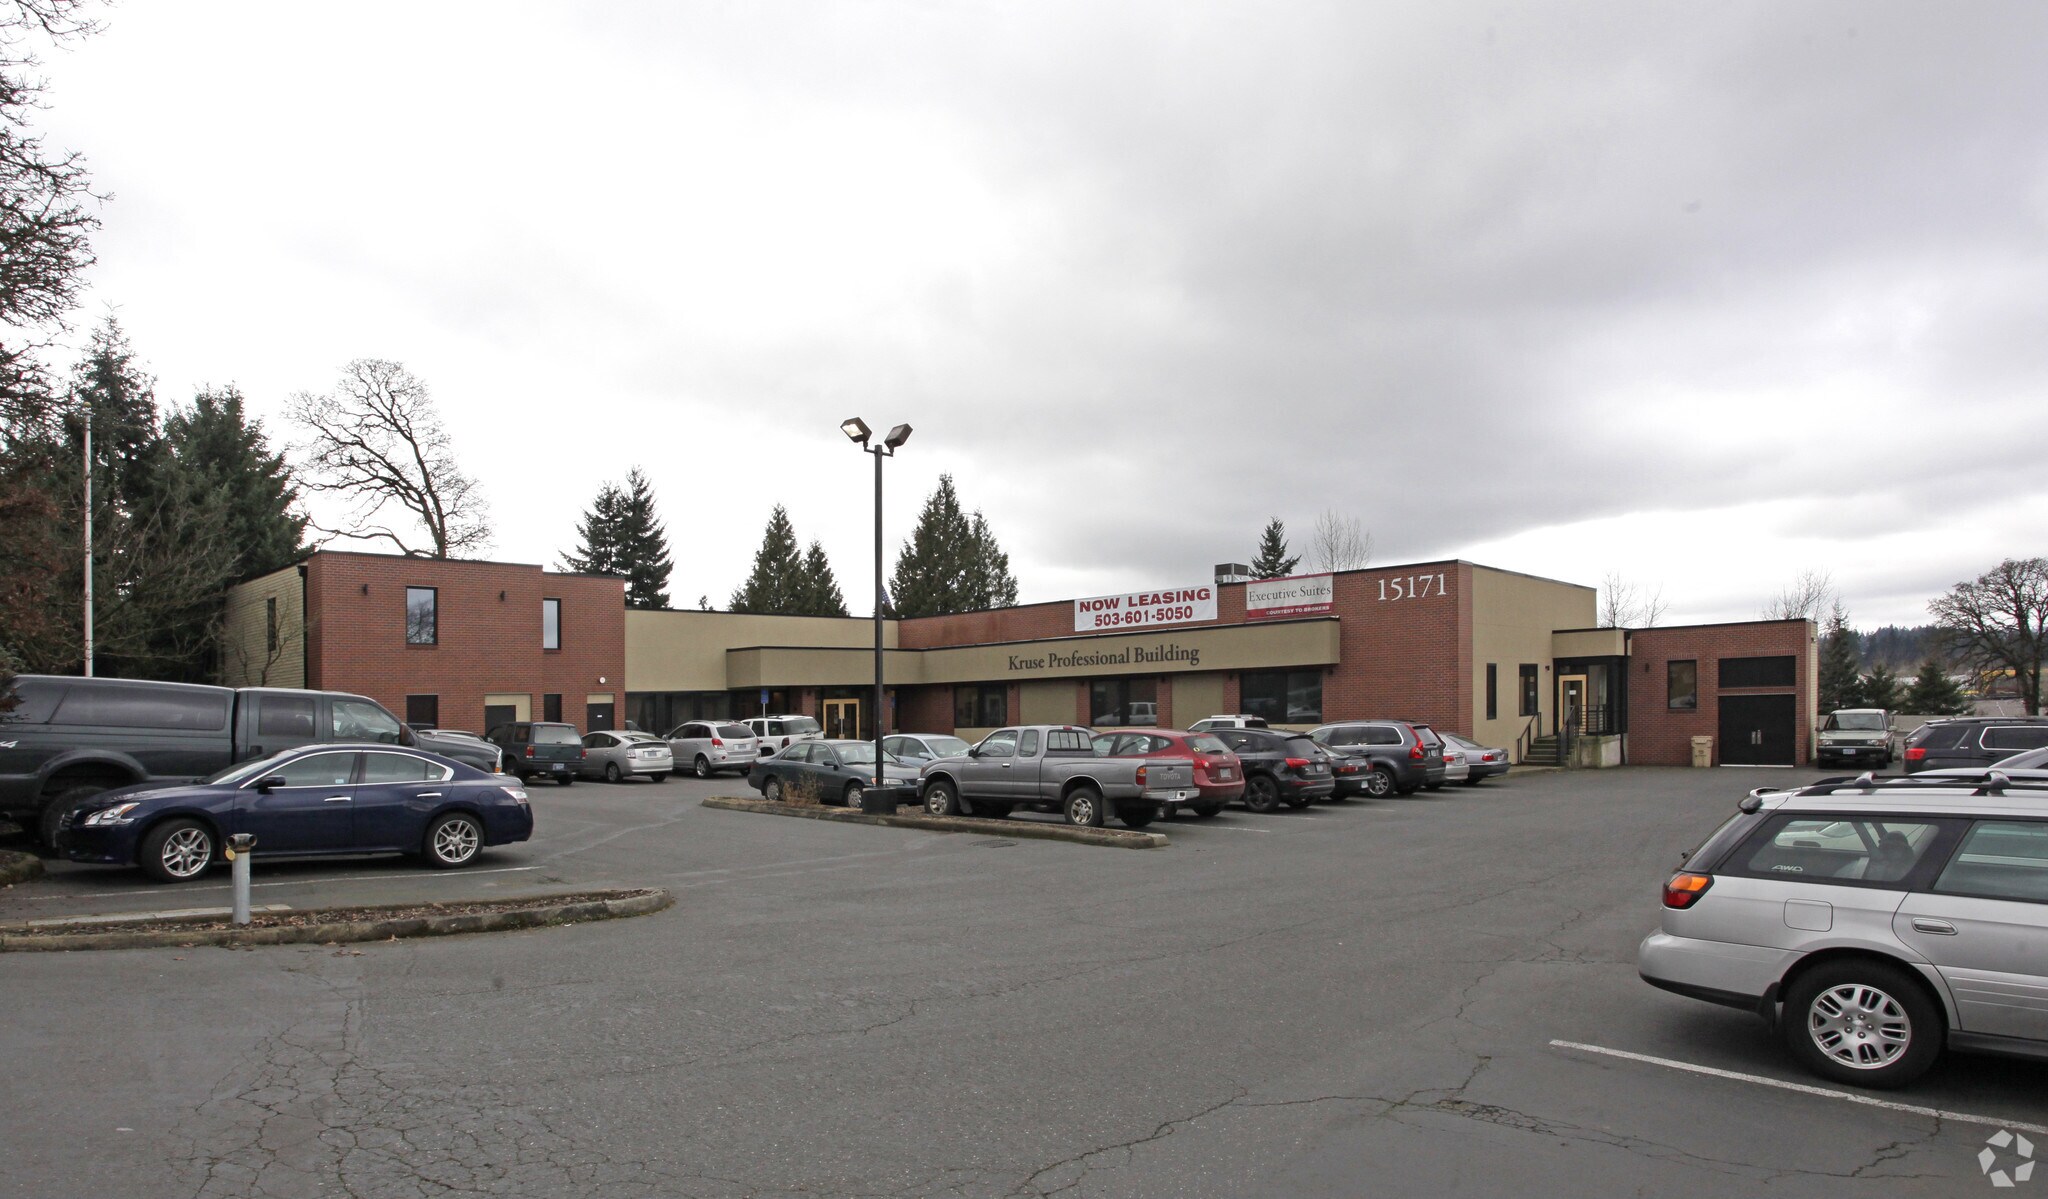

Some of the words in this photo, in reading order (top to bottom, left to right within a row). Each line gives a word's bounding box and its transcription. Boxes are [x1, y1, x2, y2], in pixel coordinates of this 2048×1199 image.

[1248, 588, 1297, 602] Executive
[1299, 585, 1331, 597] Suites
[1378, 573, 1447, 601] 15171
[1079, 597, 1120, 613] NOW
[1128, 588, 1211, 608] LEASING
[1094, 605, 1193, 627] 503-601-5050
[1008, 655, 1045, 670] Kruse
[1048, 647, 1130, 668] Professional
[1134, 644, 1200, 666] Building
[1771, 864, 1803, 872] AWD
